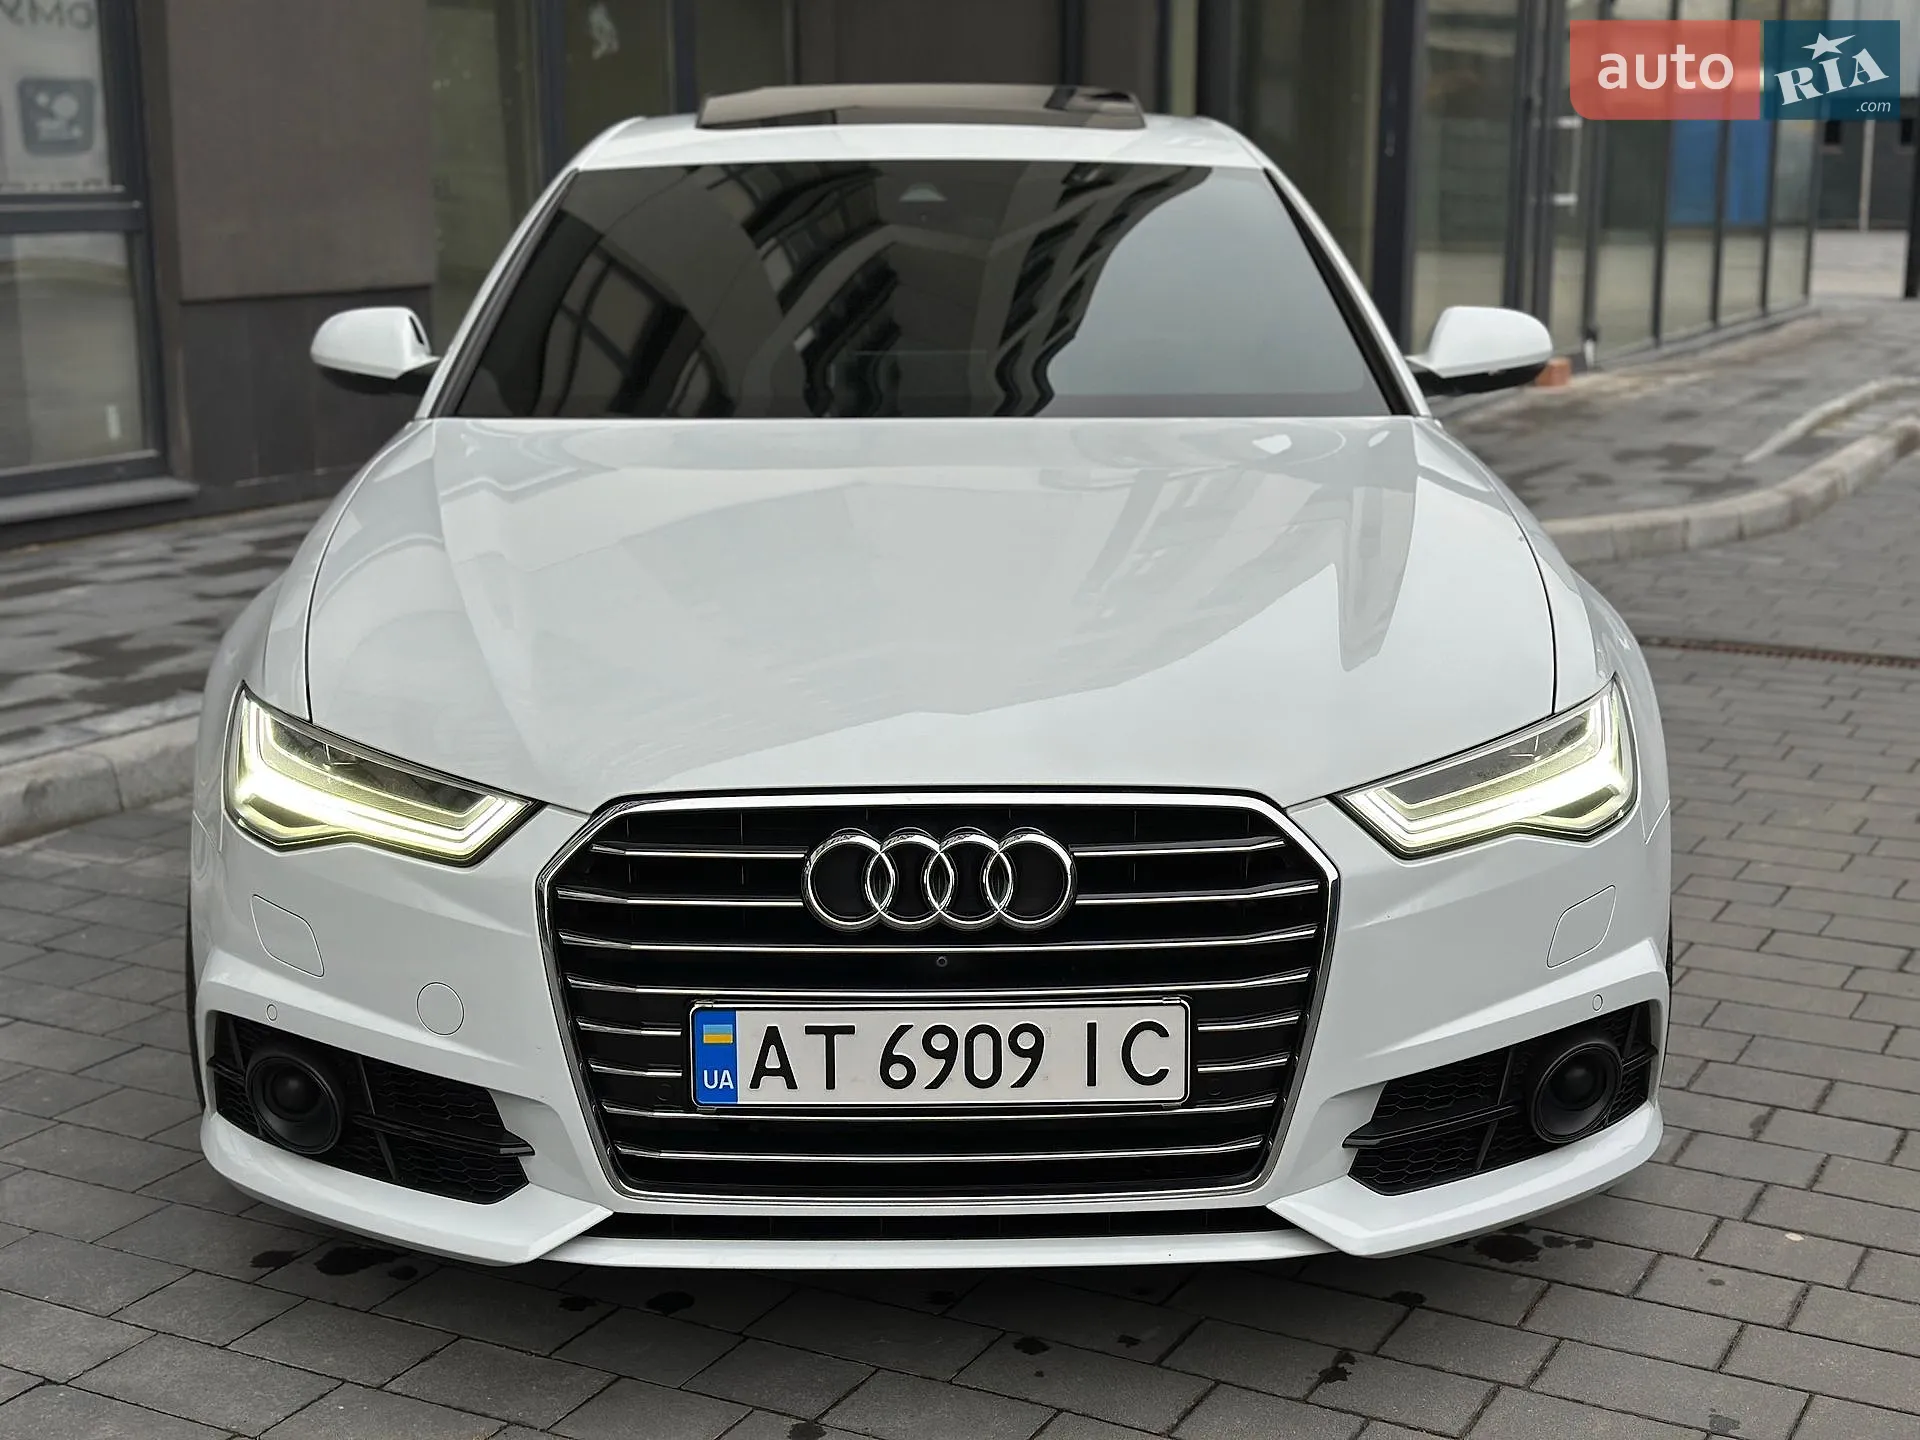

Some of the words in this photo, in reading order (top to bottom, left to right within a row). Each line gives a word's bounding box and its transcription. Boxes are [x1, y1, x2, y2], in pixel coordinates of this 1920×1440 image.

[748, 1025, 856, 1090] AT
[879, 1023, 1045, 1090] 6909
[1086, 1020, 1170, 1087] IC
[703, 1069, 734, 1090] UA
